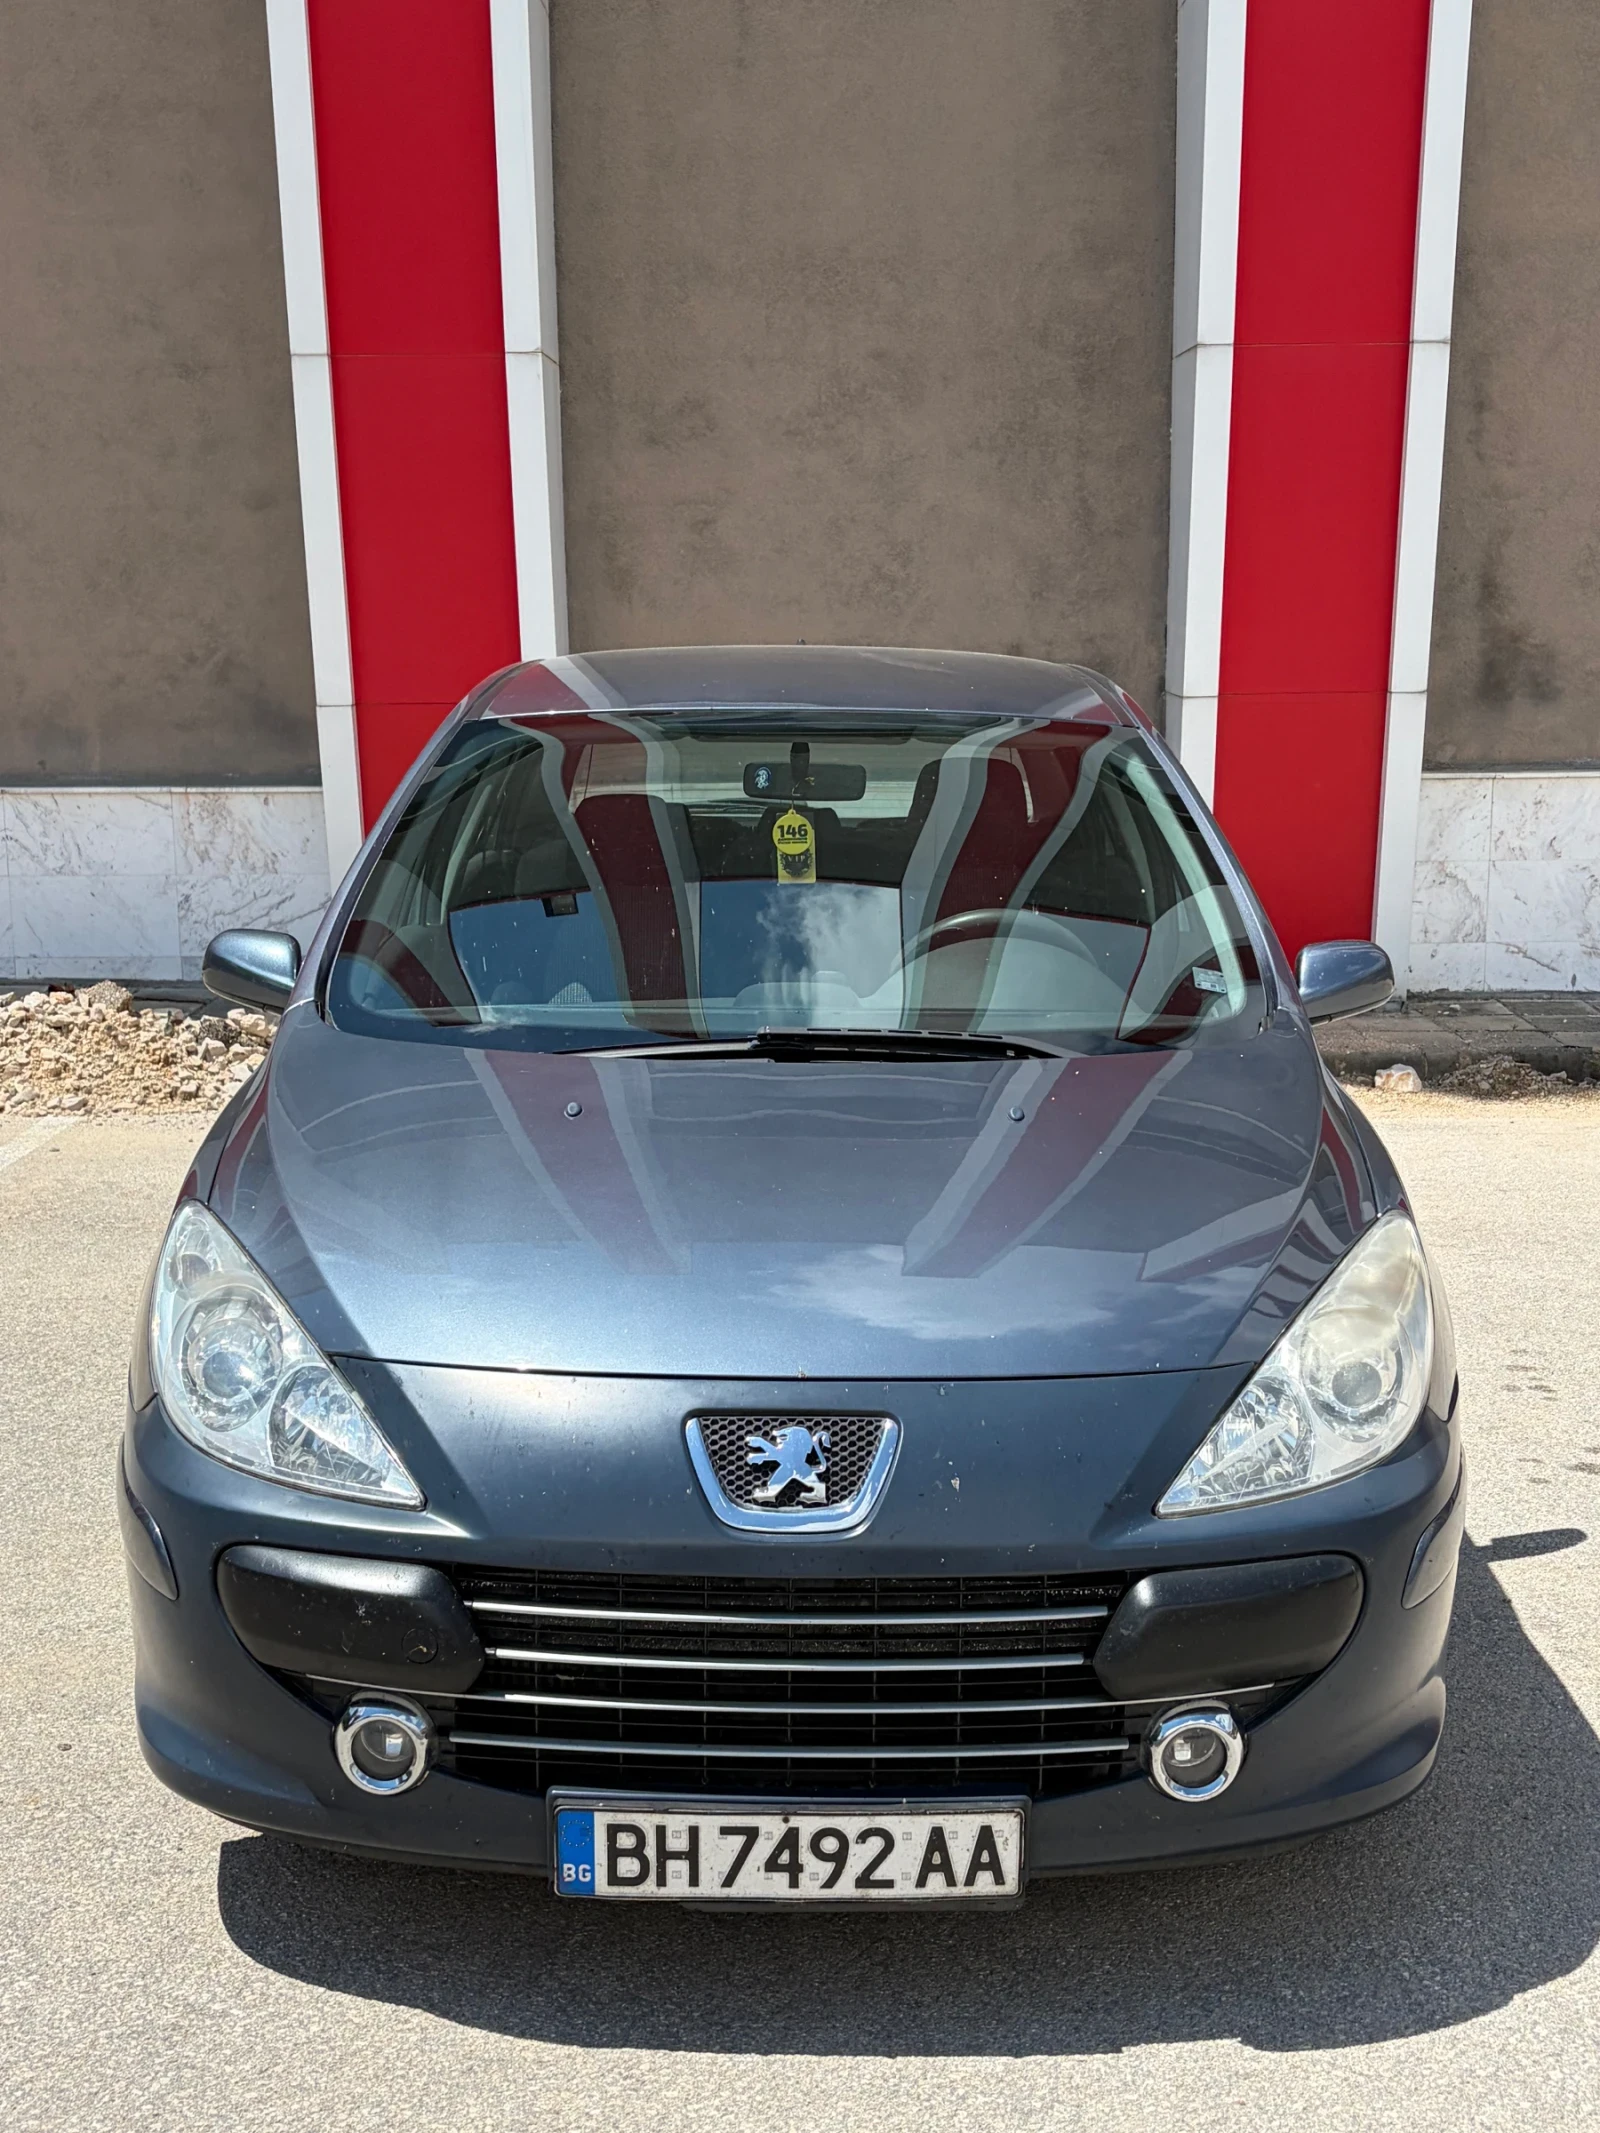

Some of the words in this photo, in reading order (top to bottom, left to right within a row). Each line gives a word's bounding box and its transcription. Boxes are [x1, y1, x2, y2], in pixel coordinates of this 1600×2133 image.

[777, 824, 808, 838] 146
[607, 1824, 700, 1887] BH
[720, 1827, 895, 1889] 7492
[915, 1825, 1005, 1888] AA
[563, 1864, 592, 1883] BG
